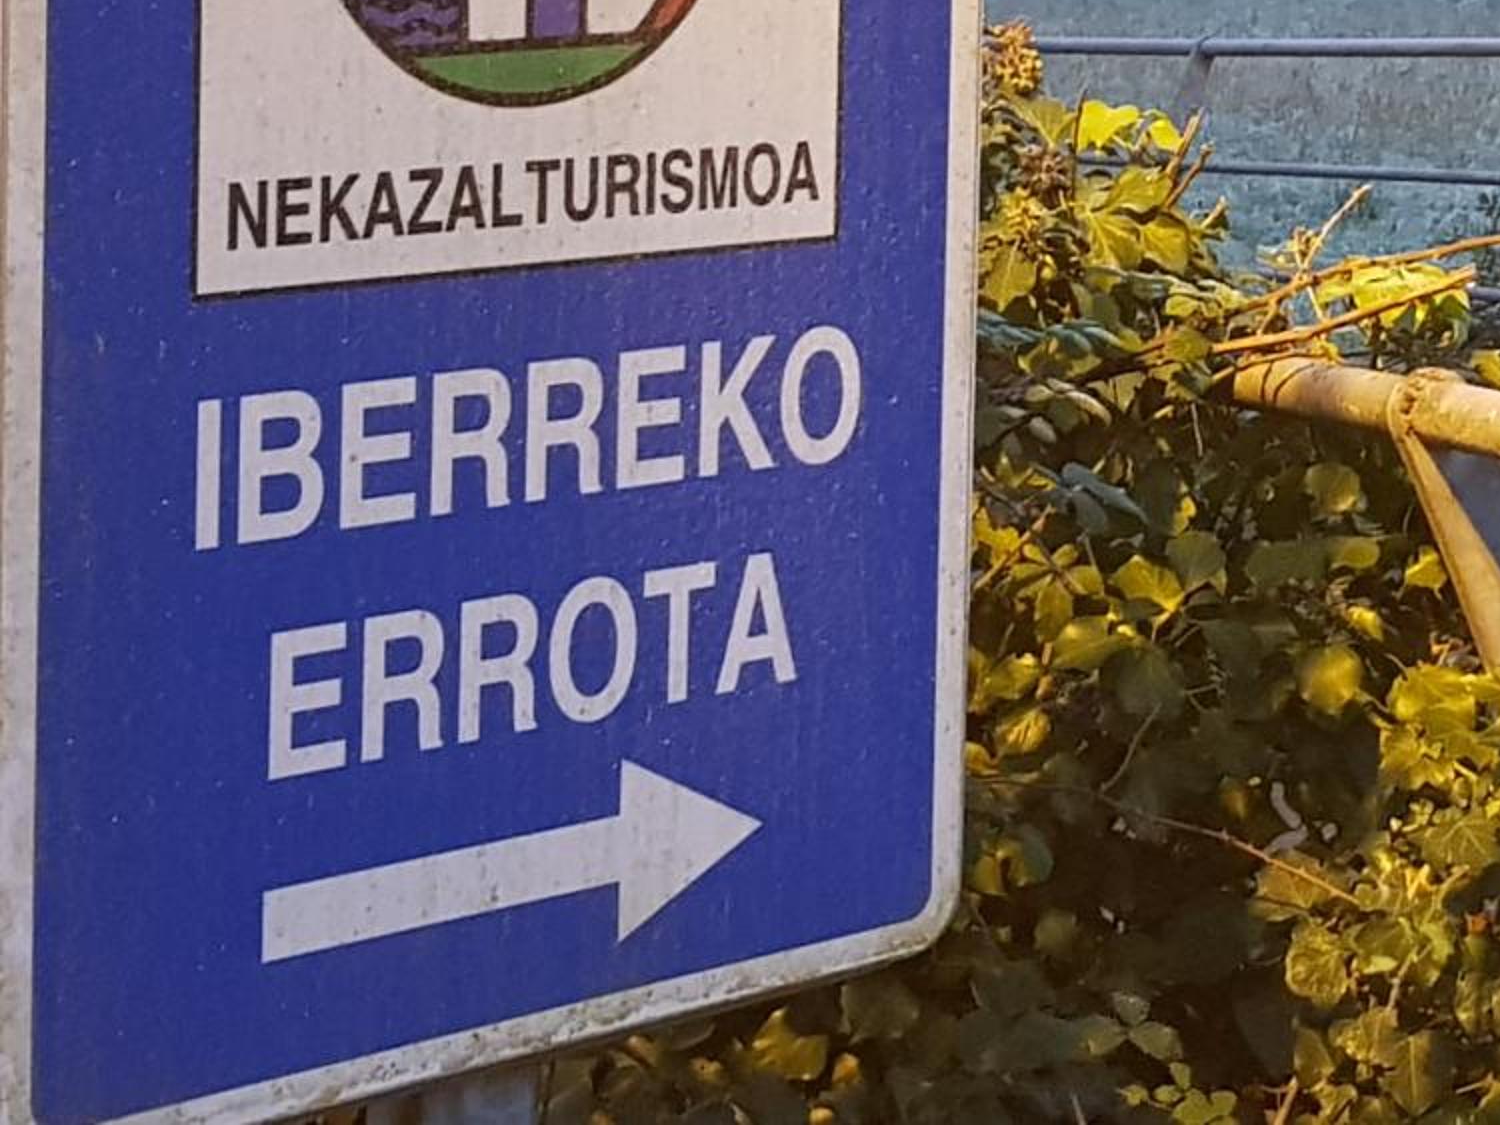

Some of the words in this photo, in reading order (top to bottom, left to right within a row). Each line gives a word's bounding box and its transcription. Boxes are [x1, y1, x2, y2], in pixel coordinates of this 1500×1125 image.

[227, 141, 819, 250] NEKAZALTURISMOA
[195, 325, 861, 551] IBERREKO
[267, 552, 797, 780] ERROTA
